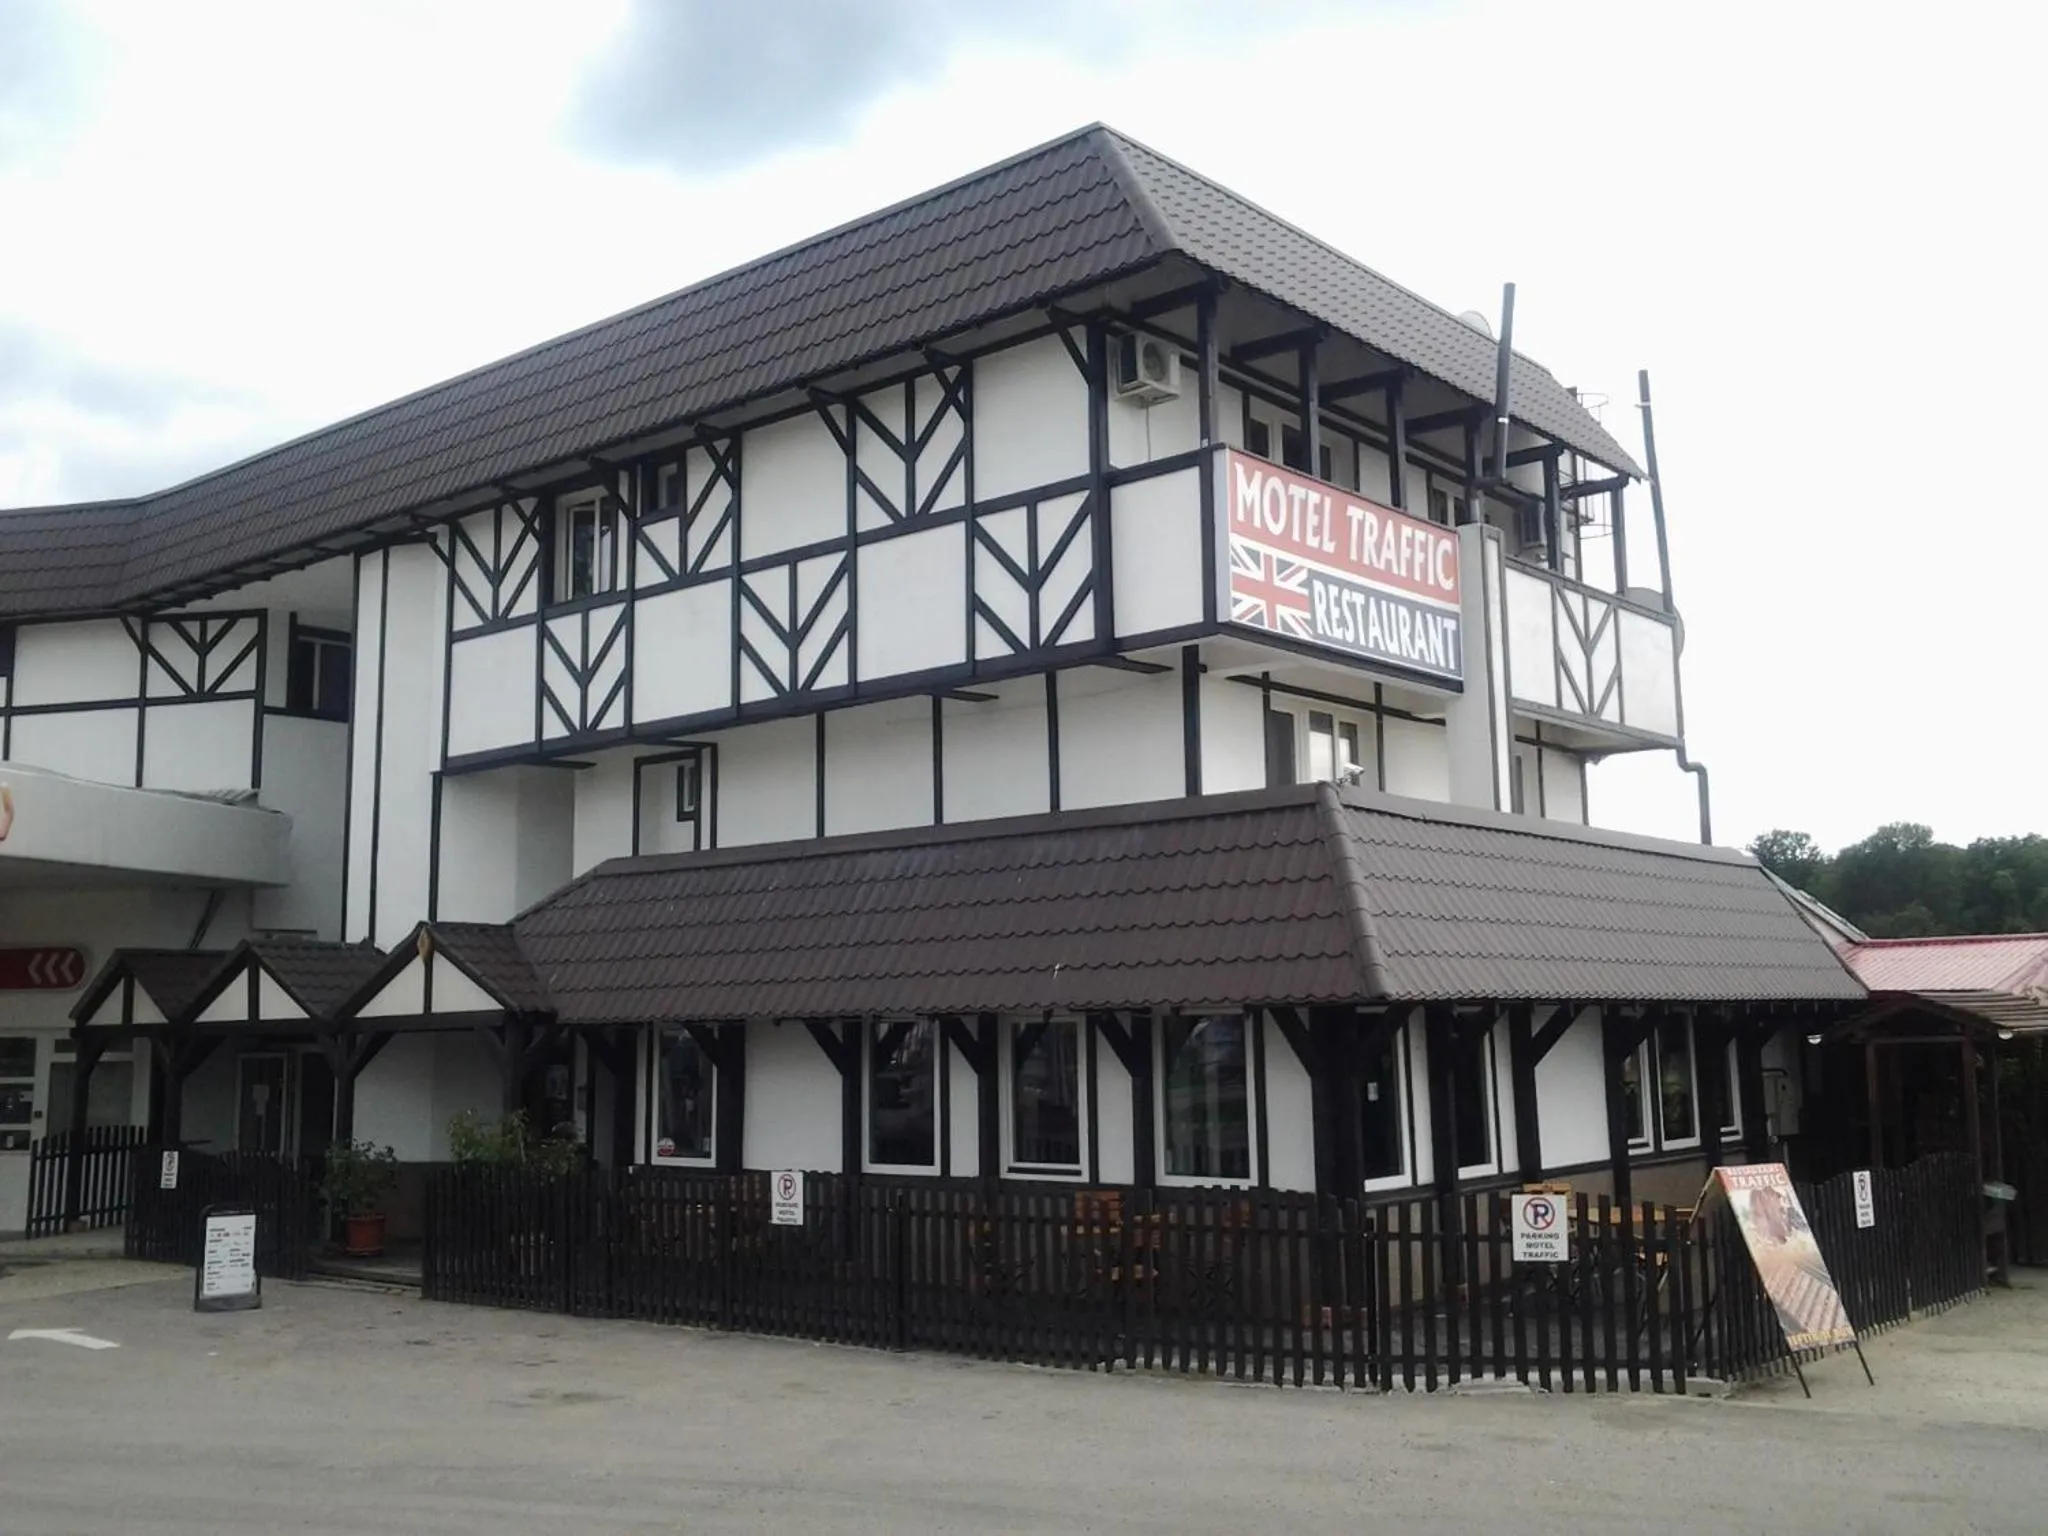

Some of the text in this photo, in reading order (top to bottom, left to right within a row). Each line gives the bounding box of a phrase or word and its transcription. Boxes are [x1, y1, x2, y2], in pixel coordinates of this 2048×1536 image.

[1234, 462, 1455, 592] MOTEL TRAFFIC
[1312, 579, 1458, 671] RESTAURANT
[1729, 1173, 1788, 1188] TRAFFIC
[1520, 1232, 1560, 1240] PARKING
[1526, 1241, 1555, 1249] MOTEL
[1522, 1251, 1559, 1259] TRAFFIC
